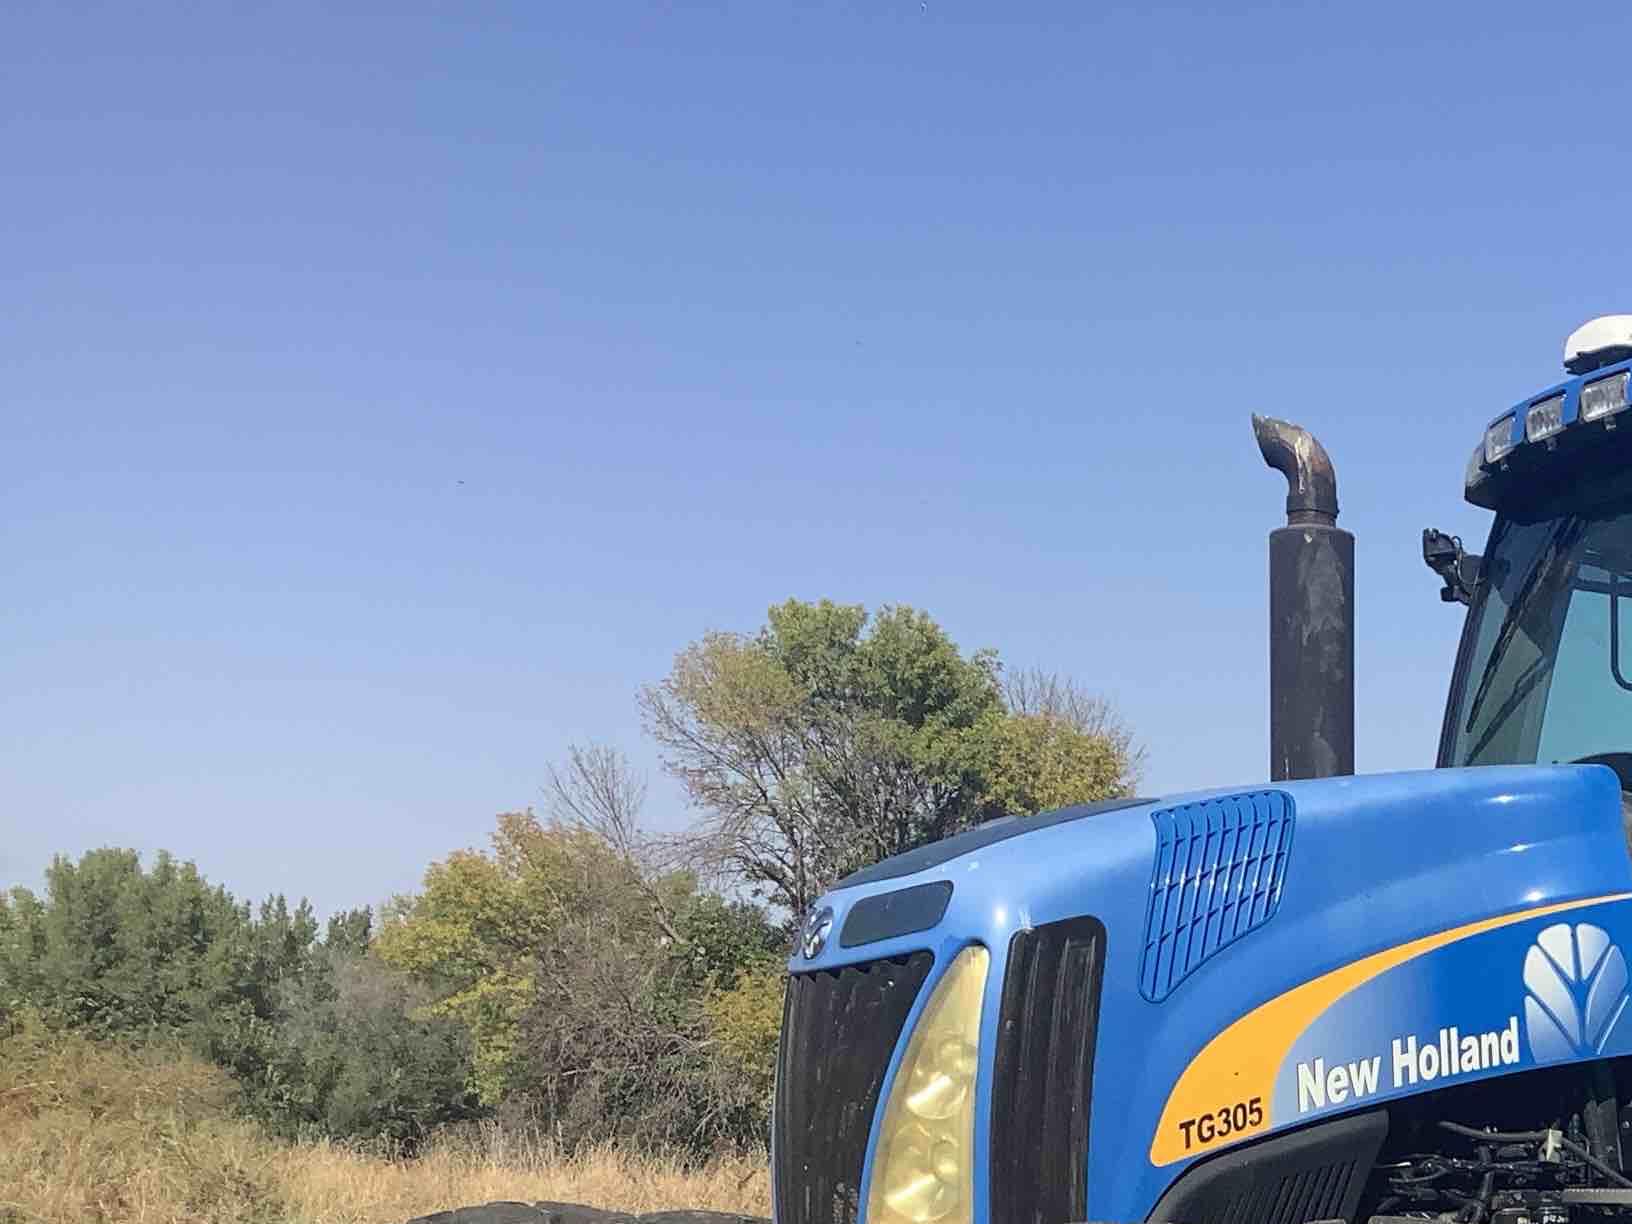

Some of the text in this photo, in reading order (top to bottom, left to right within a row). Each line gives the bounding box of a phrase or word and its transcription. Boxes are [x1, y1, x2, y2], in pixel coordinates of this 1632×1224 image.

[1296, 1016, 1519, 1112] New Holland
[1179, 1096, 1263, 1149] TG305
